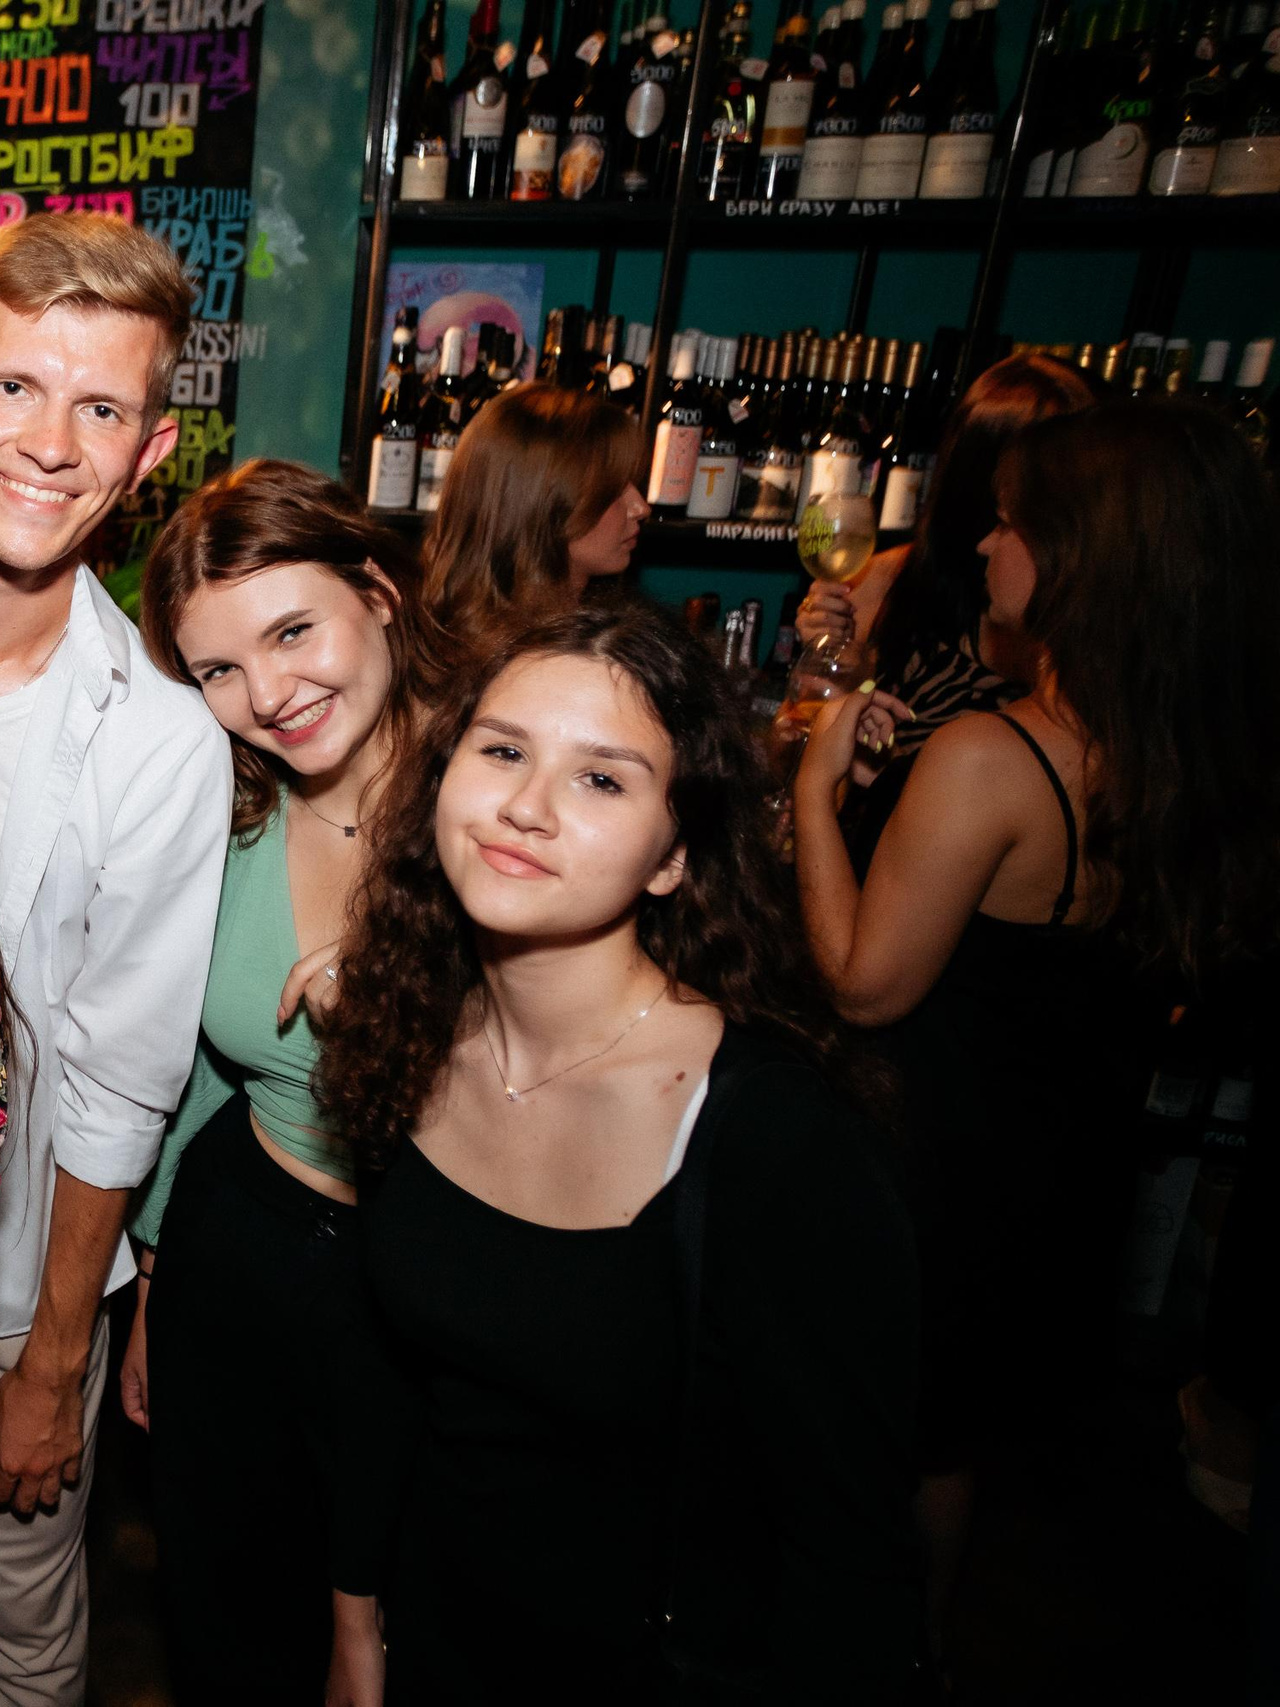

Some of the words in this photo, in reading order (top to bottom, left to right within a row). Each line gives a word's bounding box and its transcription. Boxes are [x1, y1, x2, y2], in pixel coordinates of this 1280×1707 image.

[96, 31, 250, 84] ЧИПСЫ
[118, 82, 202, 127] 100
[141, 186, 256, 222] БРИОШЬ
[725, 200, 773, 217] БЕРИ
[778, 201, 837, 217] СРАЗУ
[144, 217, 246, 271] КРАБ
[169, 361, 223, 406] 60
